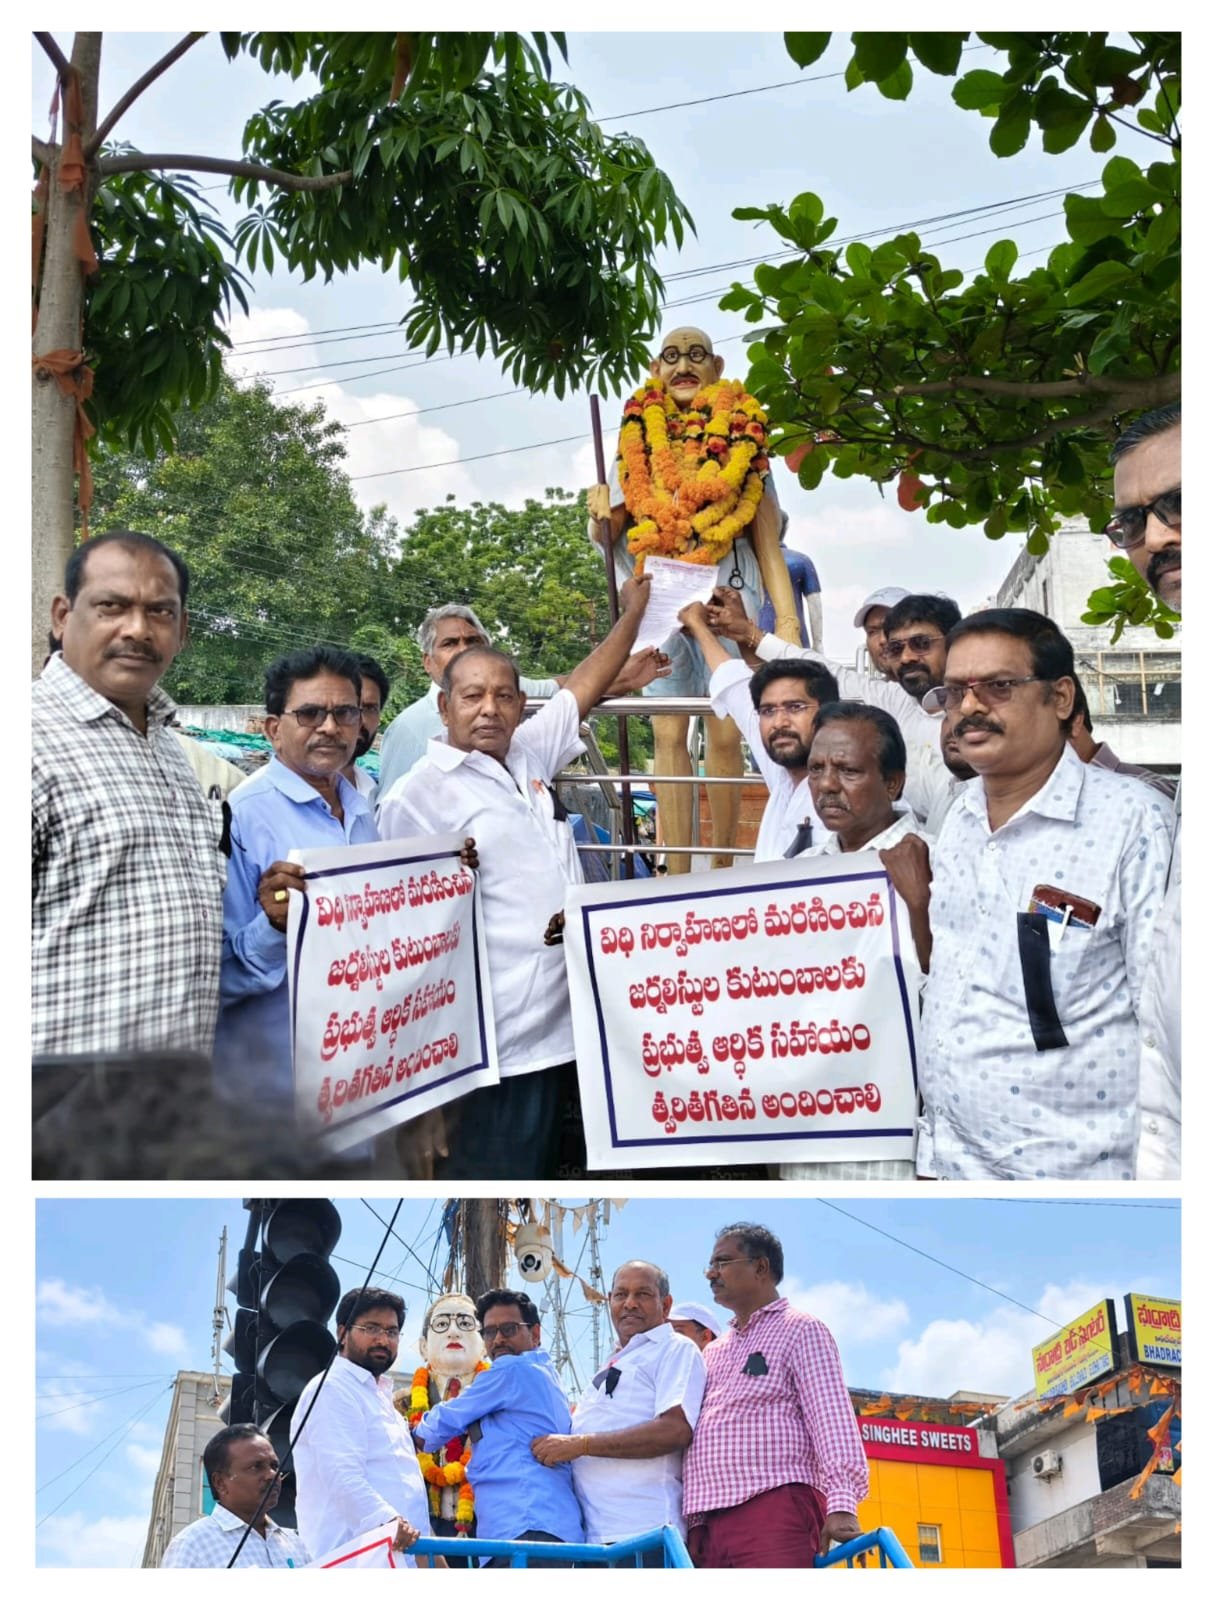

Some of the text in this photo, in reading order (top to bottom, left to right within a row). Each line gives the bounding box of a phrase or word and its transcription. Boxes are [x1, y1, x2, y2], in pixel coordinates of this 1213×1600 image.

[600, 928, 635, 958] విధి
[764, 893, 884, 937] మరణించిన
[629, 956, 866, 1016] జర్నలిస్టుల కుటుంబాలకు
[641, 1030, 710, 1078] ప్రభుత్వ
[770, 1019, 871, 1058] సహాయం
[652, 1083, 882, 1134] త్వరితగతిన అందించాలి
[862, 1424, 972, 1451] SINGHEE SWEETS
